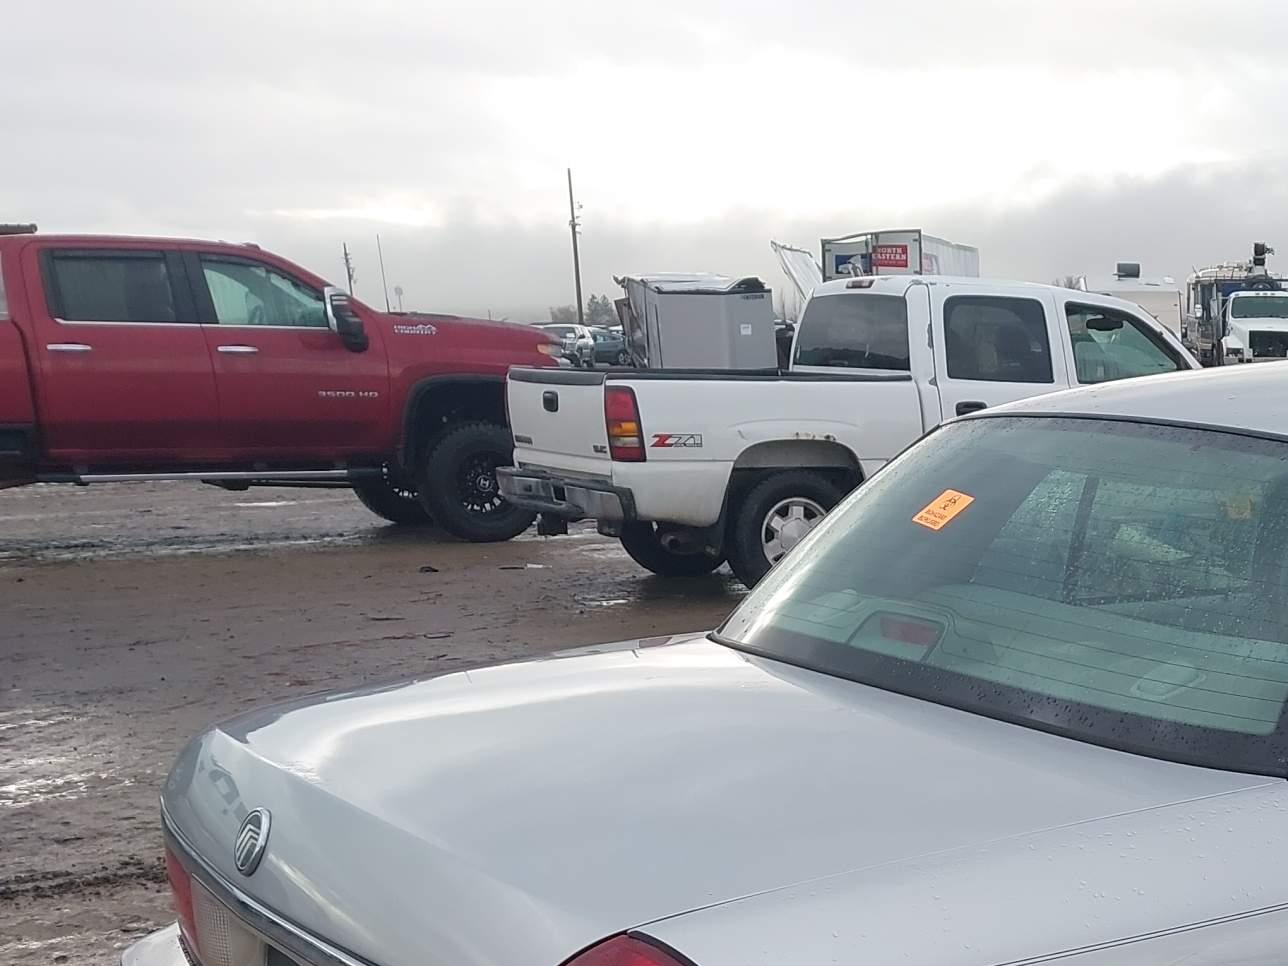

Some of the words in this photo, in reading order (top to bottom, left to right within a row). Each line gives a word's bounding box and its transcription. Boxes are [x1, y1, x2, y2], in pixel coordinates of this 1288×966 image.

[318, 390, 355, 398] 3500
[359, 390, 379, 398] HD
[650, 433, 703, 448] Z71
